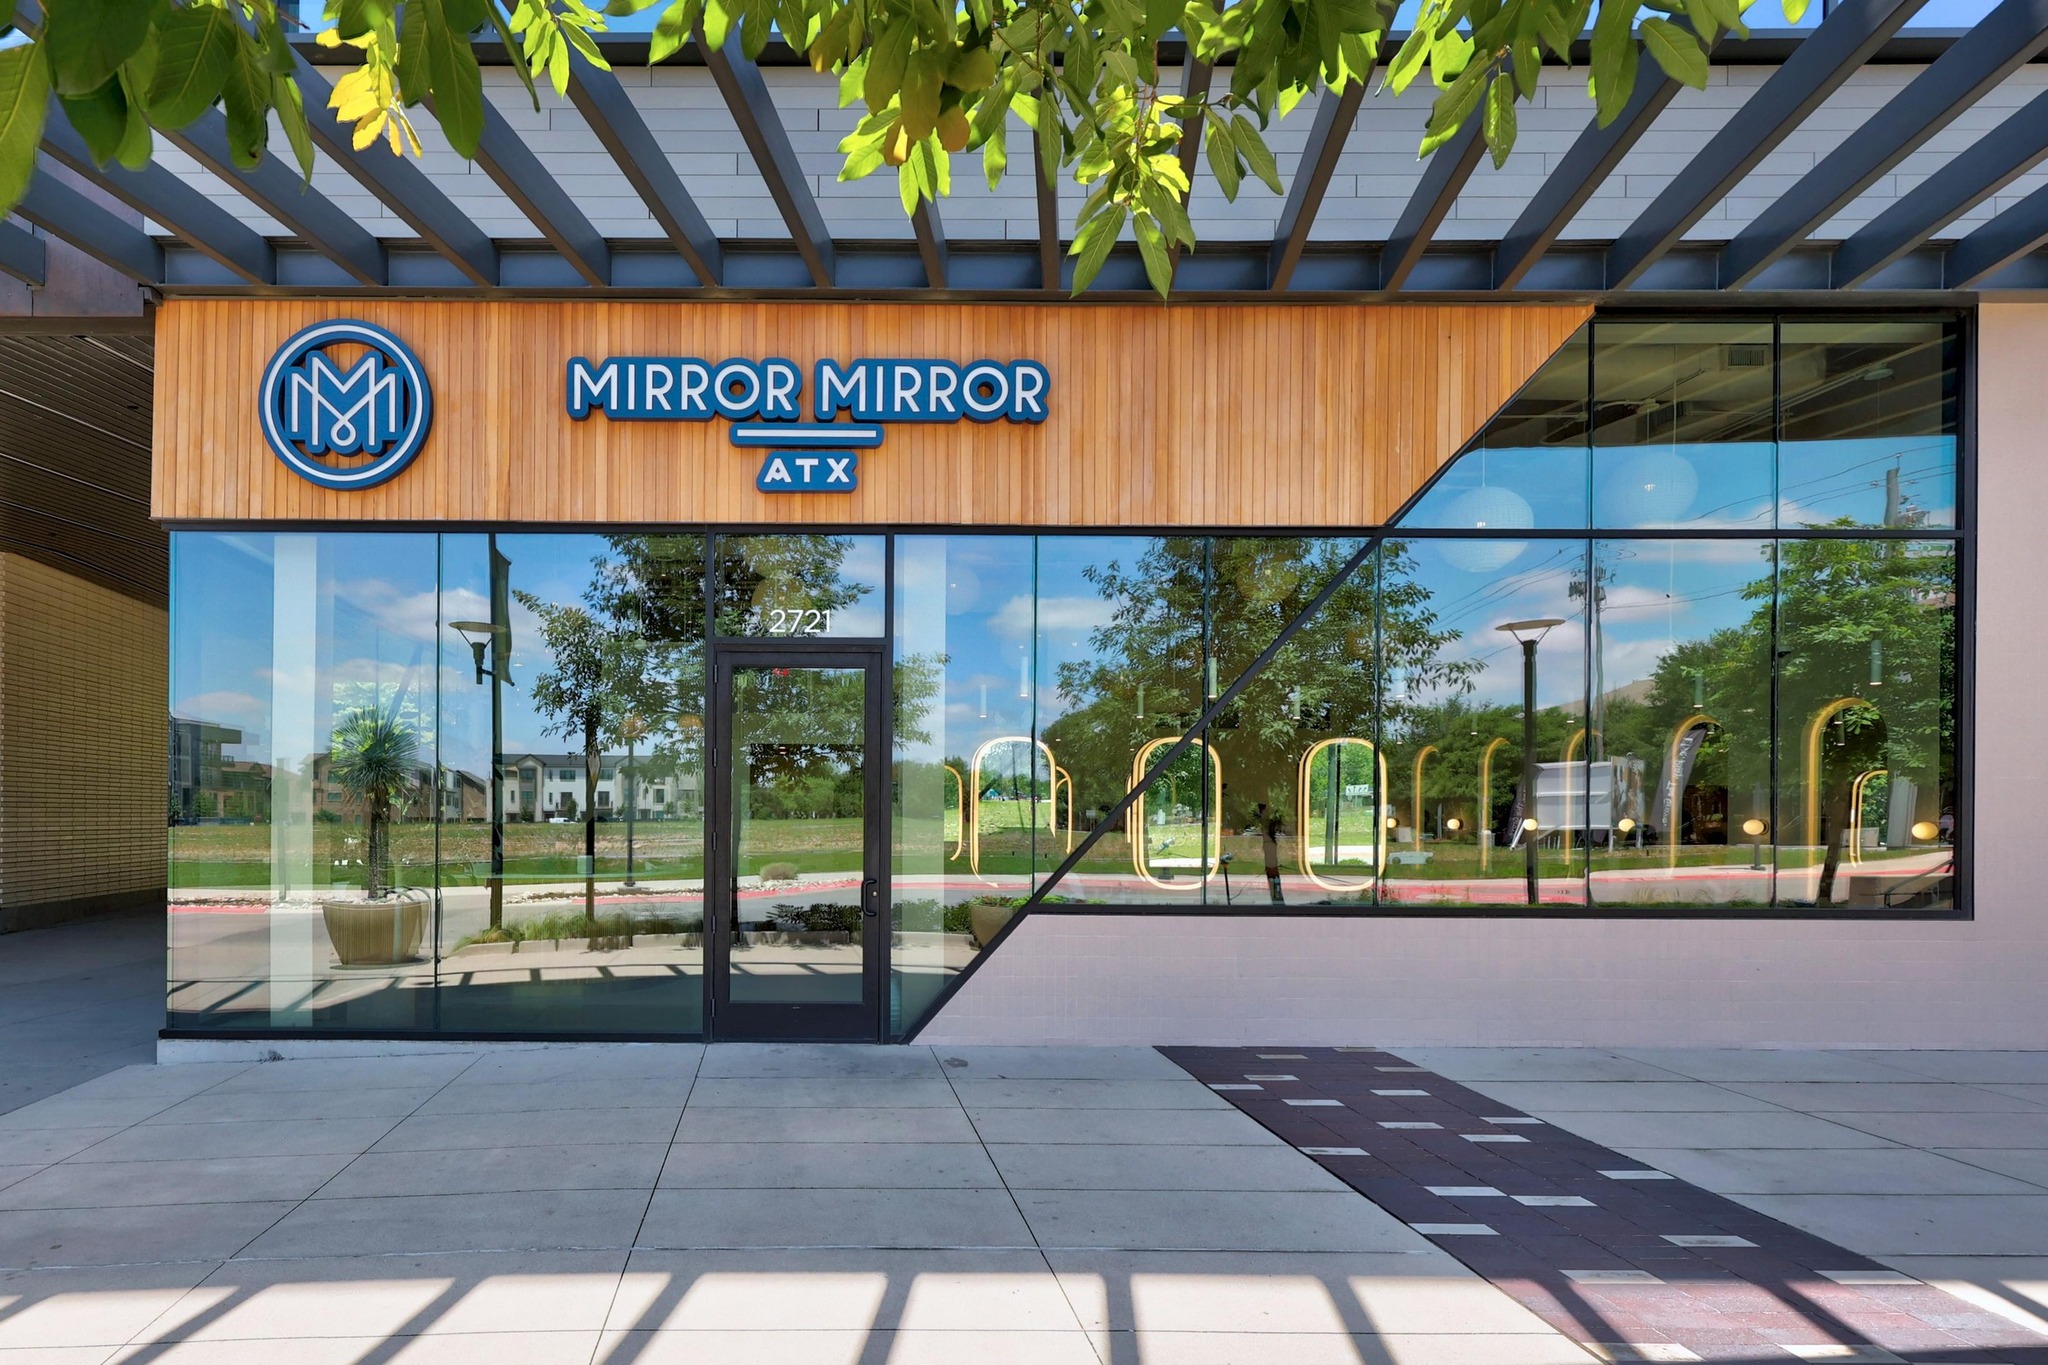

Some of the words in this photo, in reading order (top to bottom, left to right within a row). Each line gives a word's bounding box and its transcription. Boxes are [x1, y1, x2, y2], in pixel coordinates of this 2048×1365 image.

[573, 363, 795, 413] MIRROR
[821, 365, 1044, 414] MIRROR
[763, 458, 850, 483] ATX
[769, 609, 831, 633] 2721
